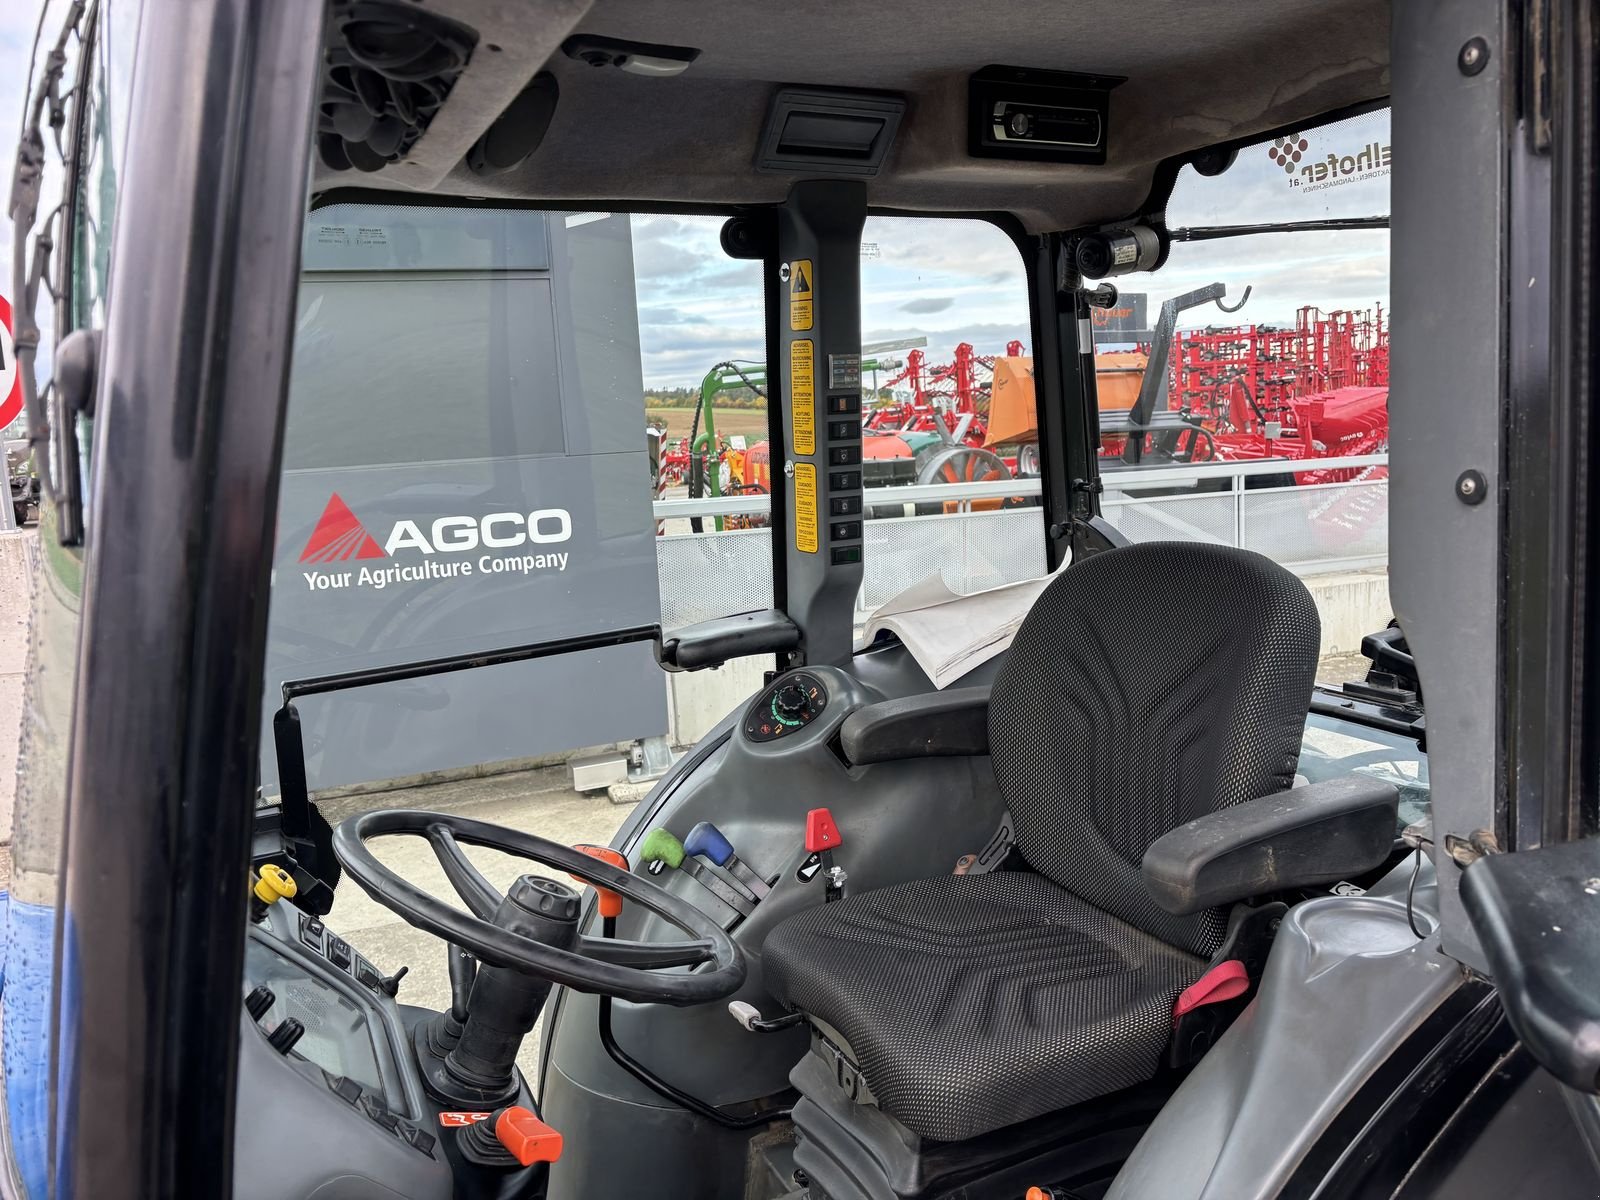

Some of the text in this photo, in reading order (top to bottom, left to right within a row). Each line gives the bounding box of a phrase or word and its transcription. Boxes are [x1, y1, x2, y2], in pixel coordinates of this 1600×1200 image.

[385, 508, 572, 557] AGCO
[303, 552, 569, 591] Your Agriculture Company
